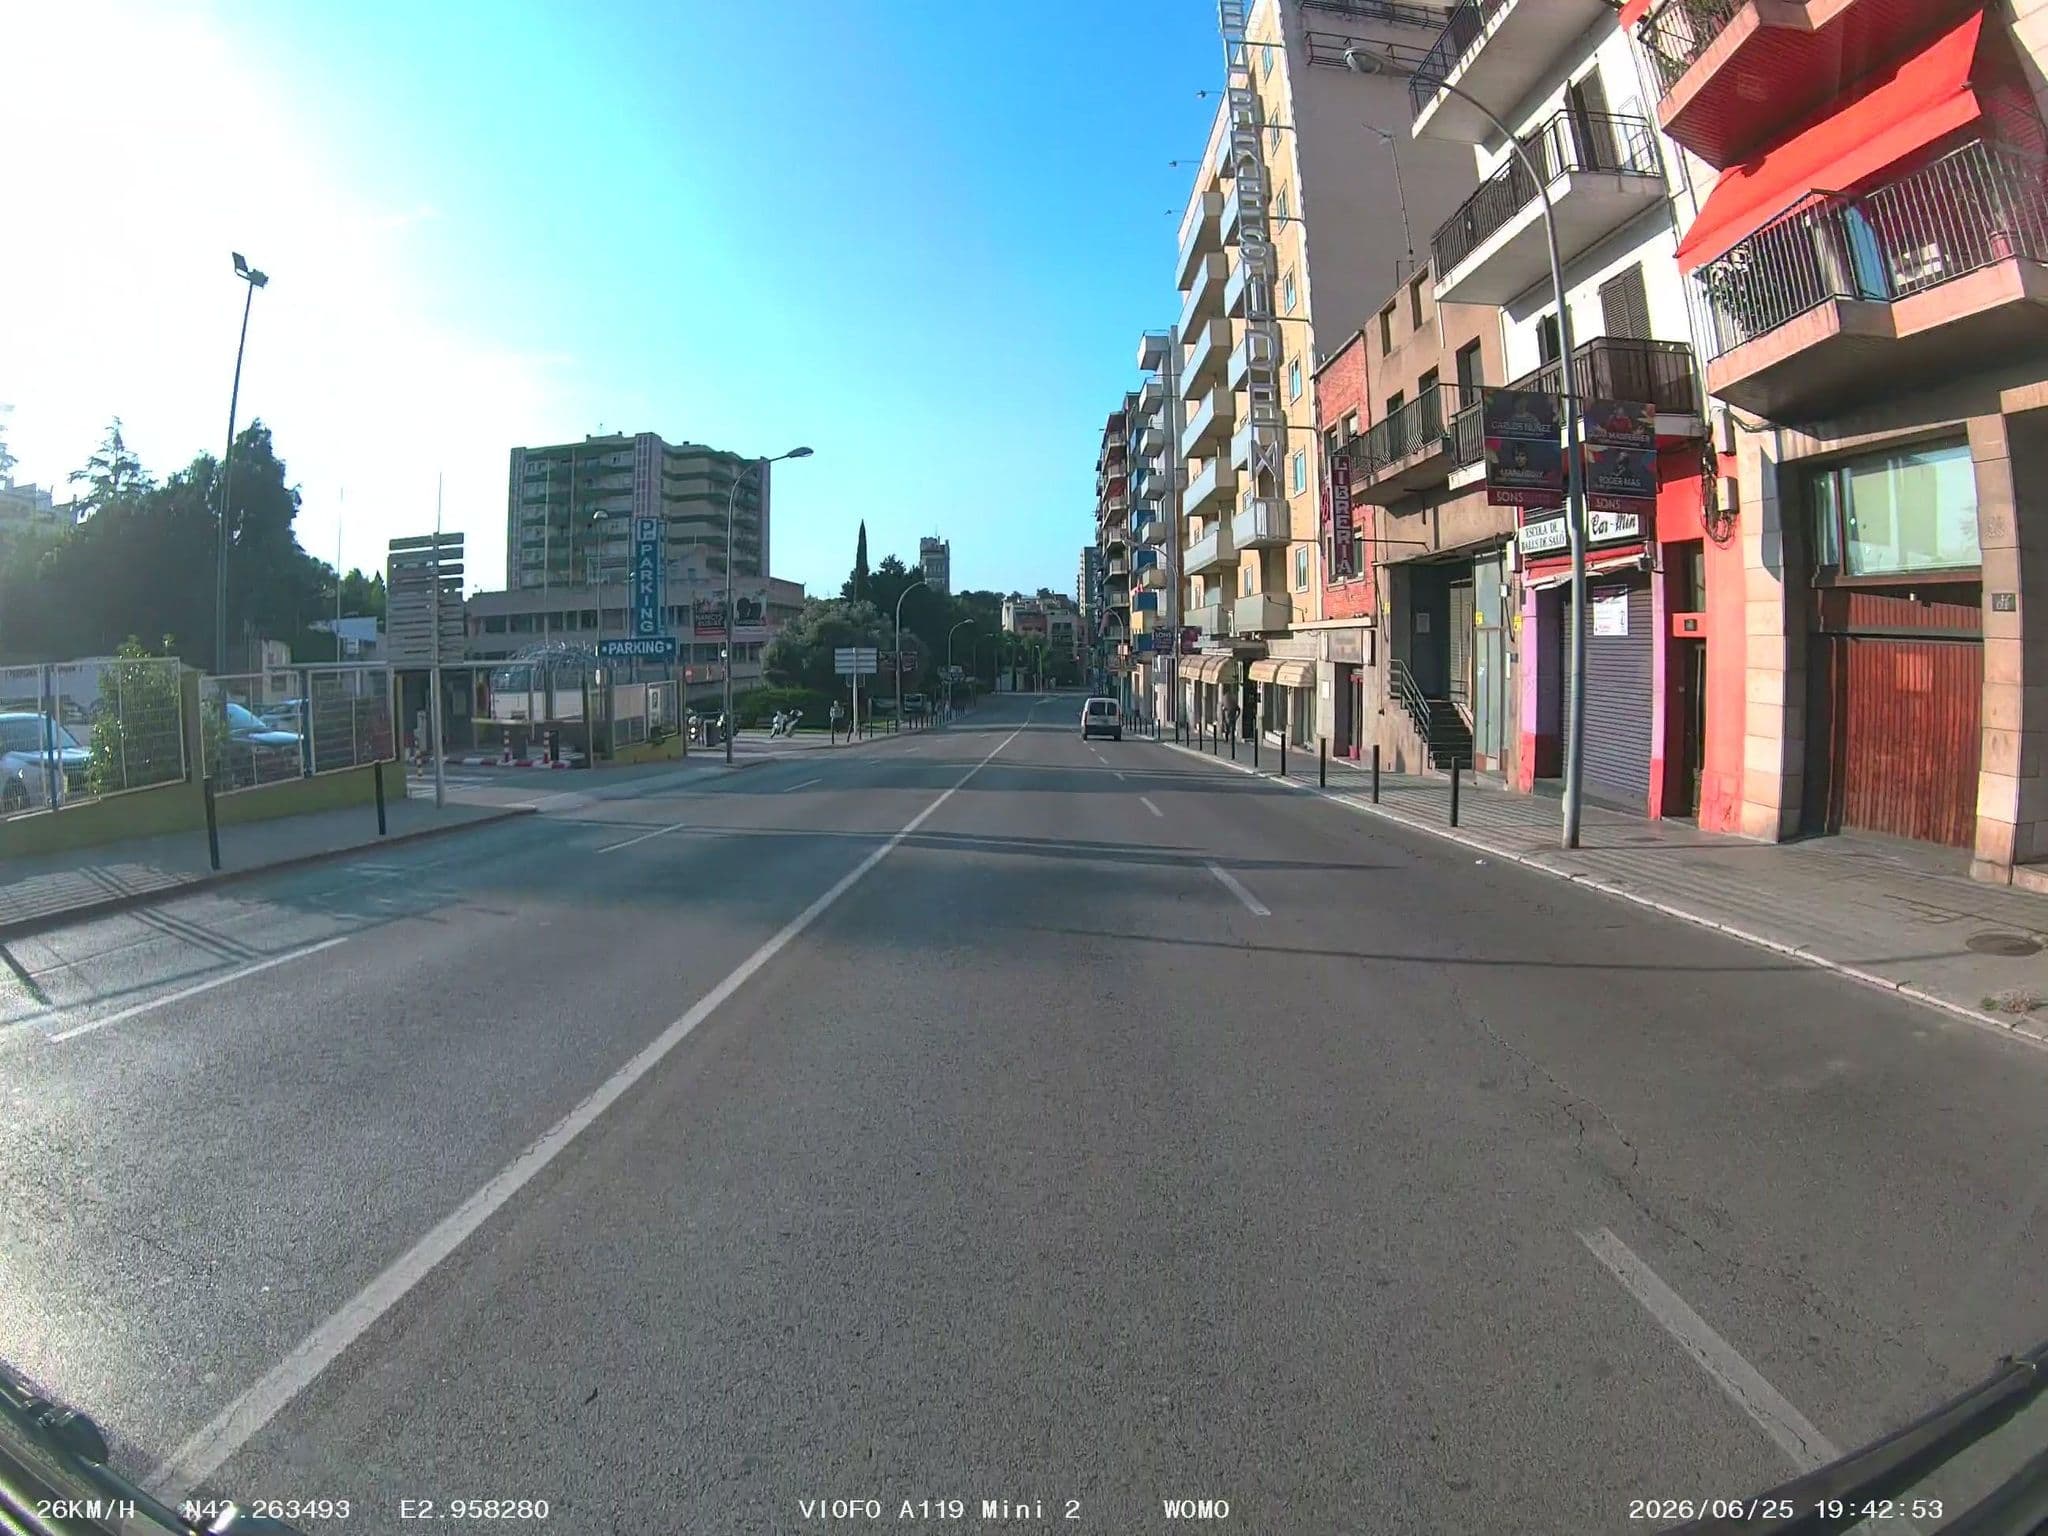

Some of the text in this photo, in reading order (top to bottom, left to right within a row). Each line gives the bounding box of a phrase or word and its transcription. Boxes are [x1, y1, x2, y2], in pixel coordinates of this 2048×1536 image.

[1496, 490, 1524, 503] SONS
[1596, 498, 1621, 510] SONS
[1332, 456, 1353, 574] LIBRERIA
[1525, 522, 1559, 538] ESCOLA DE
[1521, 539, 1539, 552] BALLS
[1540, 537, 1548, 549] DE
[640, 544, 654, 632] PARKING
[608, 641, 665, 655] PARKING
